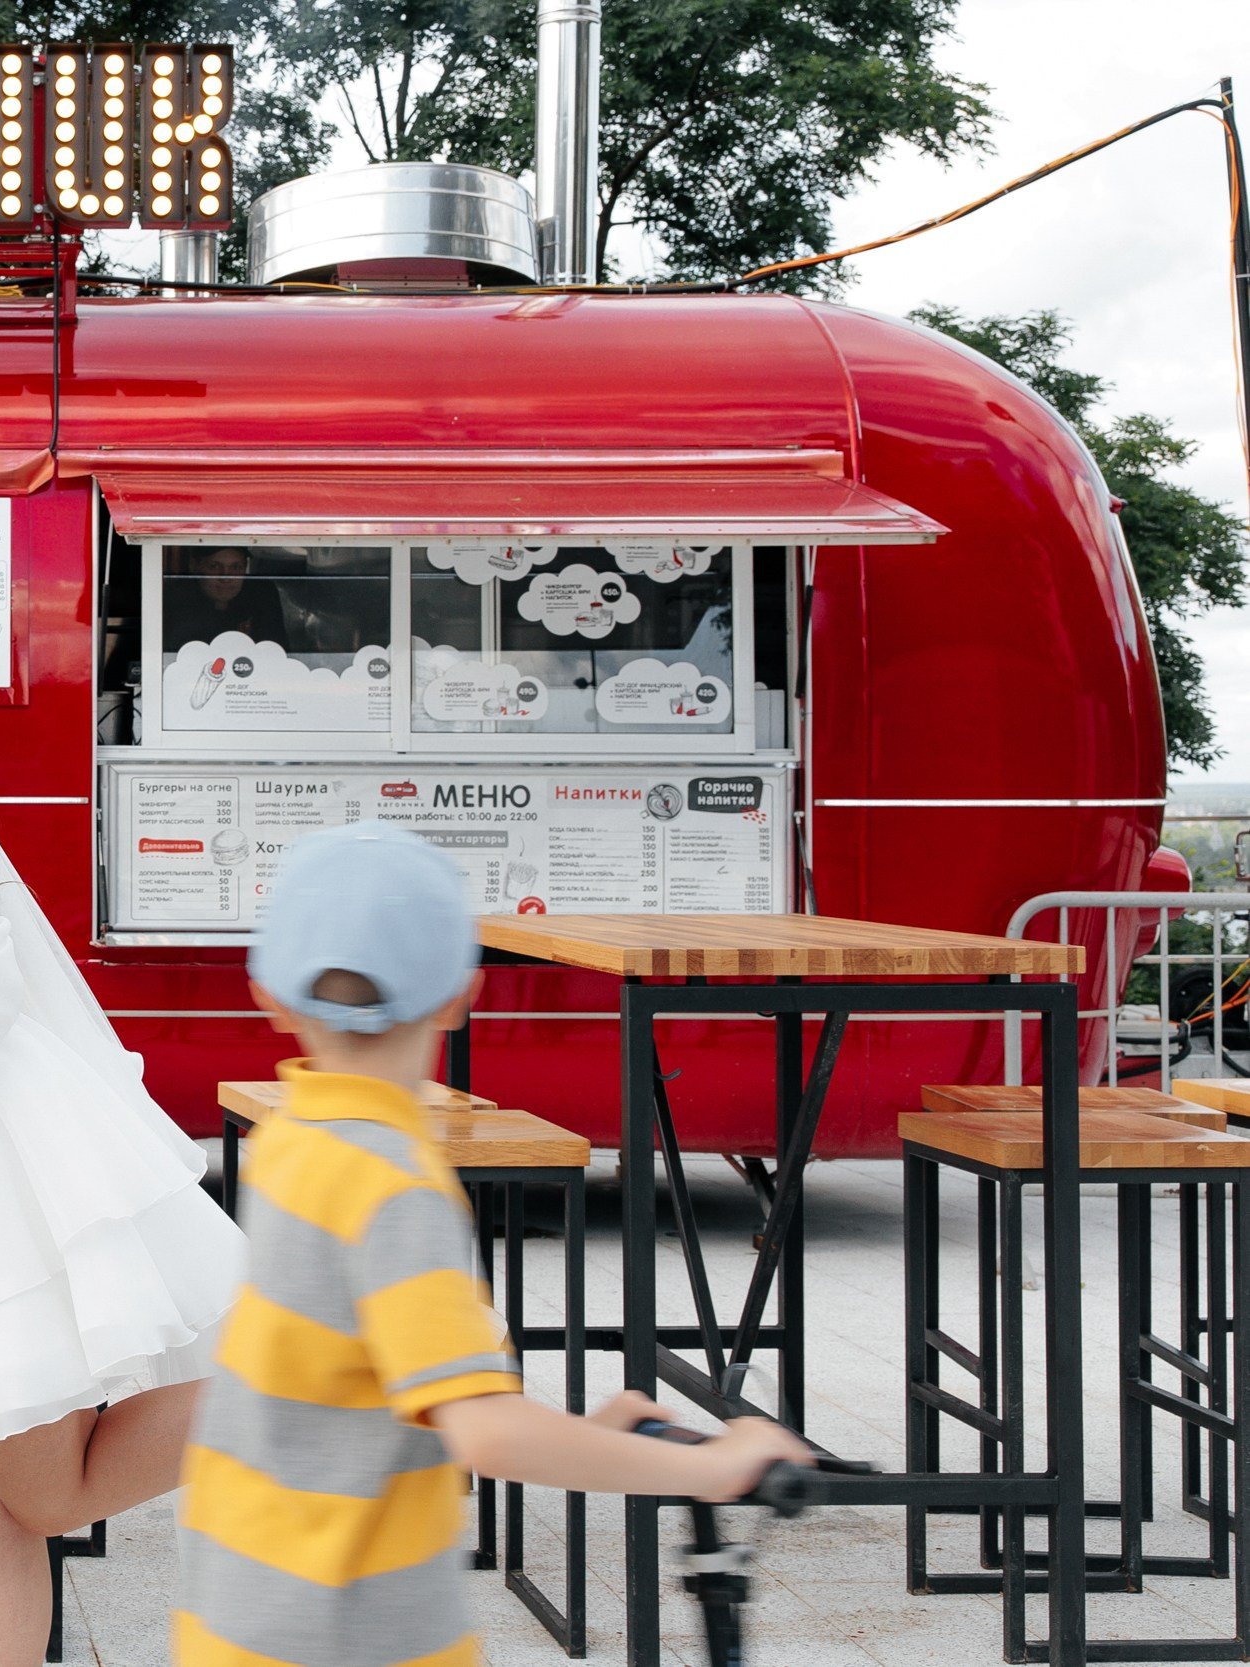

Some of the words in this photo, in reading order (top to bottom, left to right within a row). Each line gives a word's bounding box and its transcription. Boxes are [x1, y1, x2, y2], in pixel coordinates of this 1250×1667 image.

[138, 782, 187, 794] Бургеры
[190, 784, 203, 792] на
[206, 784, 232, 794] огне
[255, 780, 329, 797] Шаурма
[697, 780, 754, 794] Горячие
[432, 784, 531, 808] МЕНЮ
[555, 785, 642, 800] Напитки
[696, 796, 756, 806] напитки
[466, 812, 492, 821] 10:00
[494, 814, 507, 822] до
[510, 812, 538, 821] 22:00
[455, 836, 506, 845] стартеры
[142, 842, 200, 851] Дополнительно
[218, 877, 229, 885] 50
[484, 895, 498, 903] 150
[219, 903, 230, 911] 50
